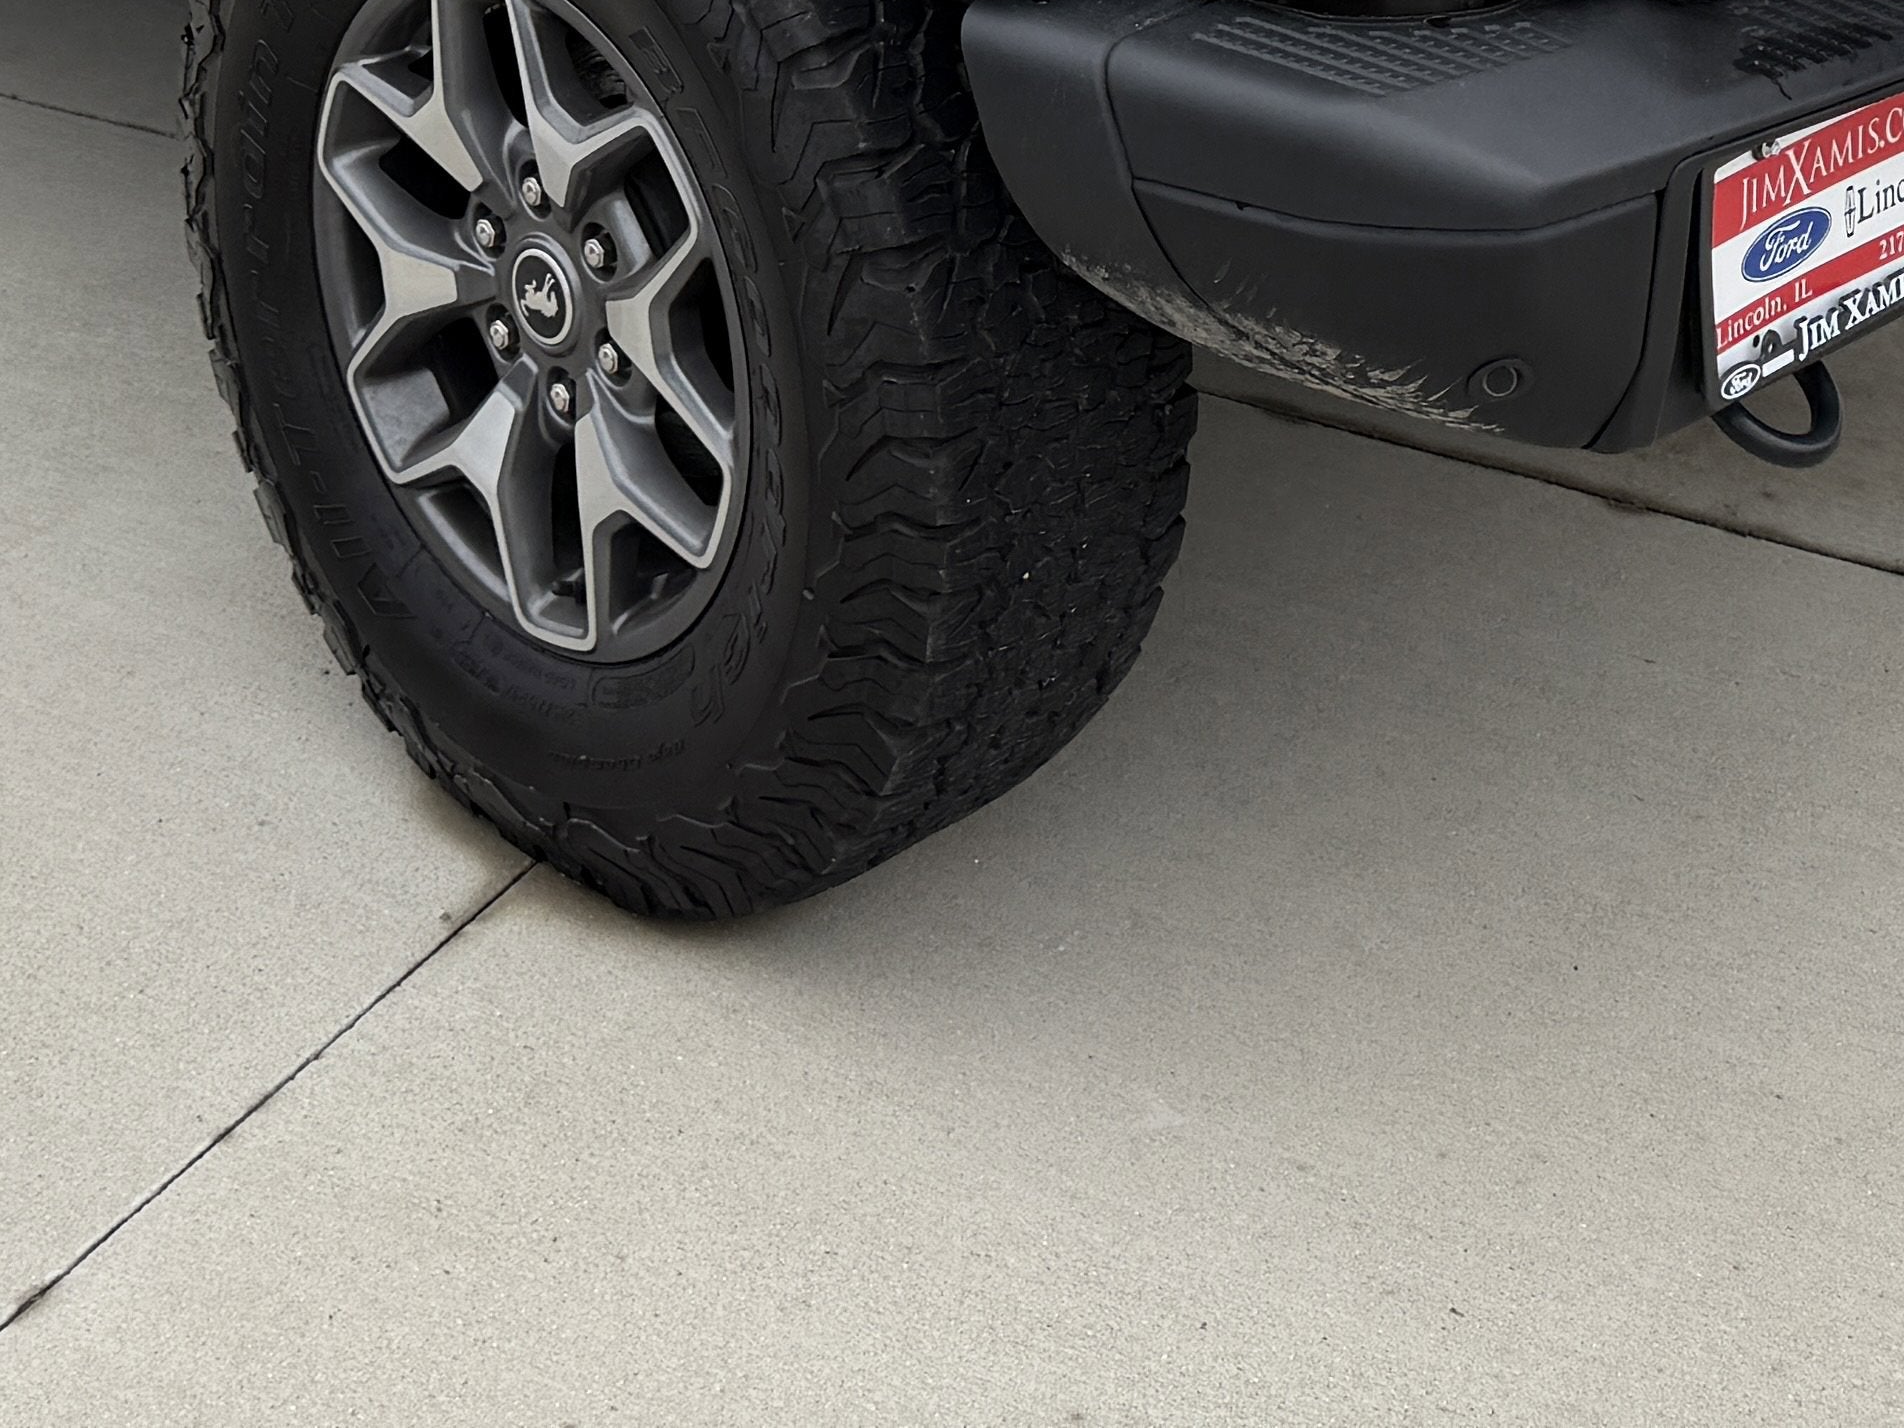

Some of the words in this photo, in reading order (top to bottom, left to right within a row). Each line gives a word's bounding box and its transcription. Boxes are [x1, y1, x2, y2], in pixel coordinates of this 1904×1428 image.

[1760, 219, 1815, 271] Ford
[1716, 297, 1788, 346] Lincoln,
[1794, 278, 1813, 299] IL
[1729, 369, 1755, 395] Ford
